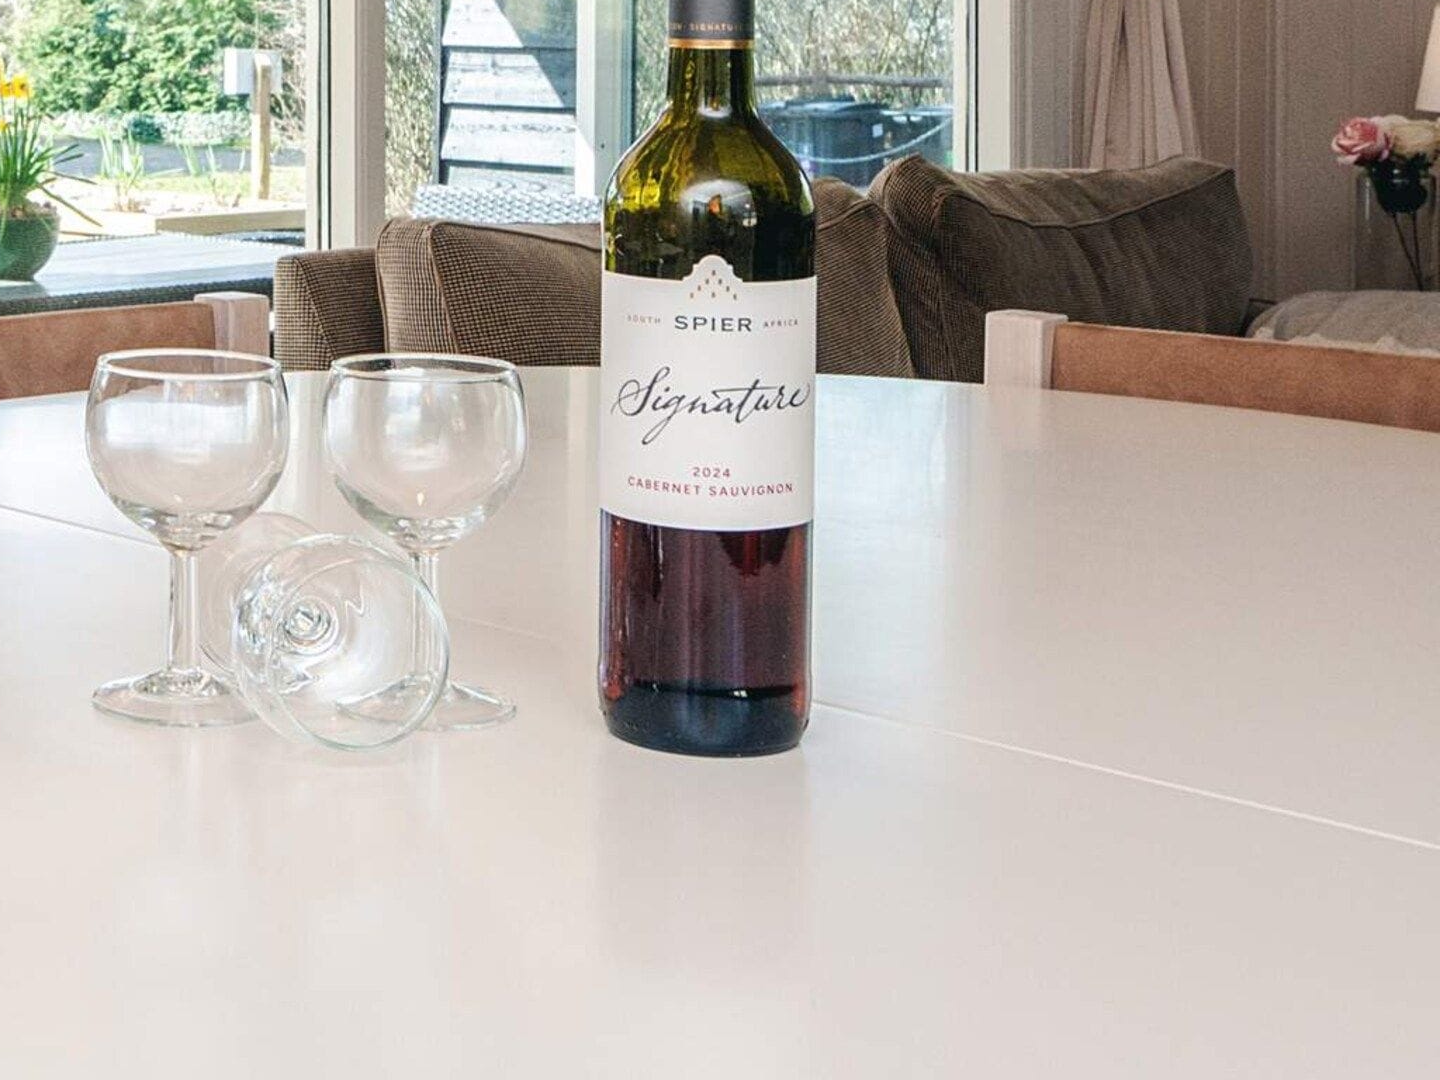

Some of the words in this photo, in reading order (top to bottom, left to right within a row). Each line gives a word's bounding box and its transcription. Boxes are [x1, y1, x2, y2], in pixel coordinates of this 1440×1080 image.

[674, 315, 752, 332] SPIER
[764, 319, 800, 328] AFRICA
[611, 366, 810, 445] Signature
[692, 466, 731, 478] 2024
[627, 476, 701, 496] CABERNET
[709, 483, 794, 497] SAUVIGNON
